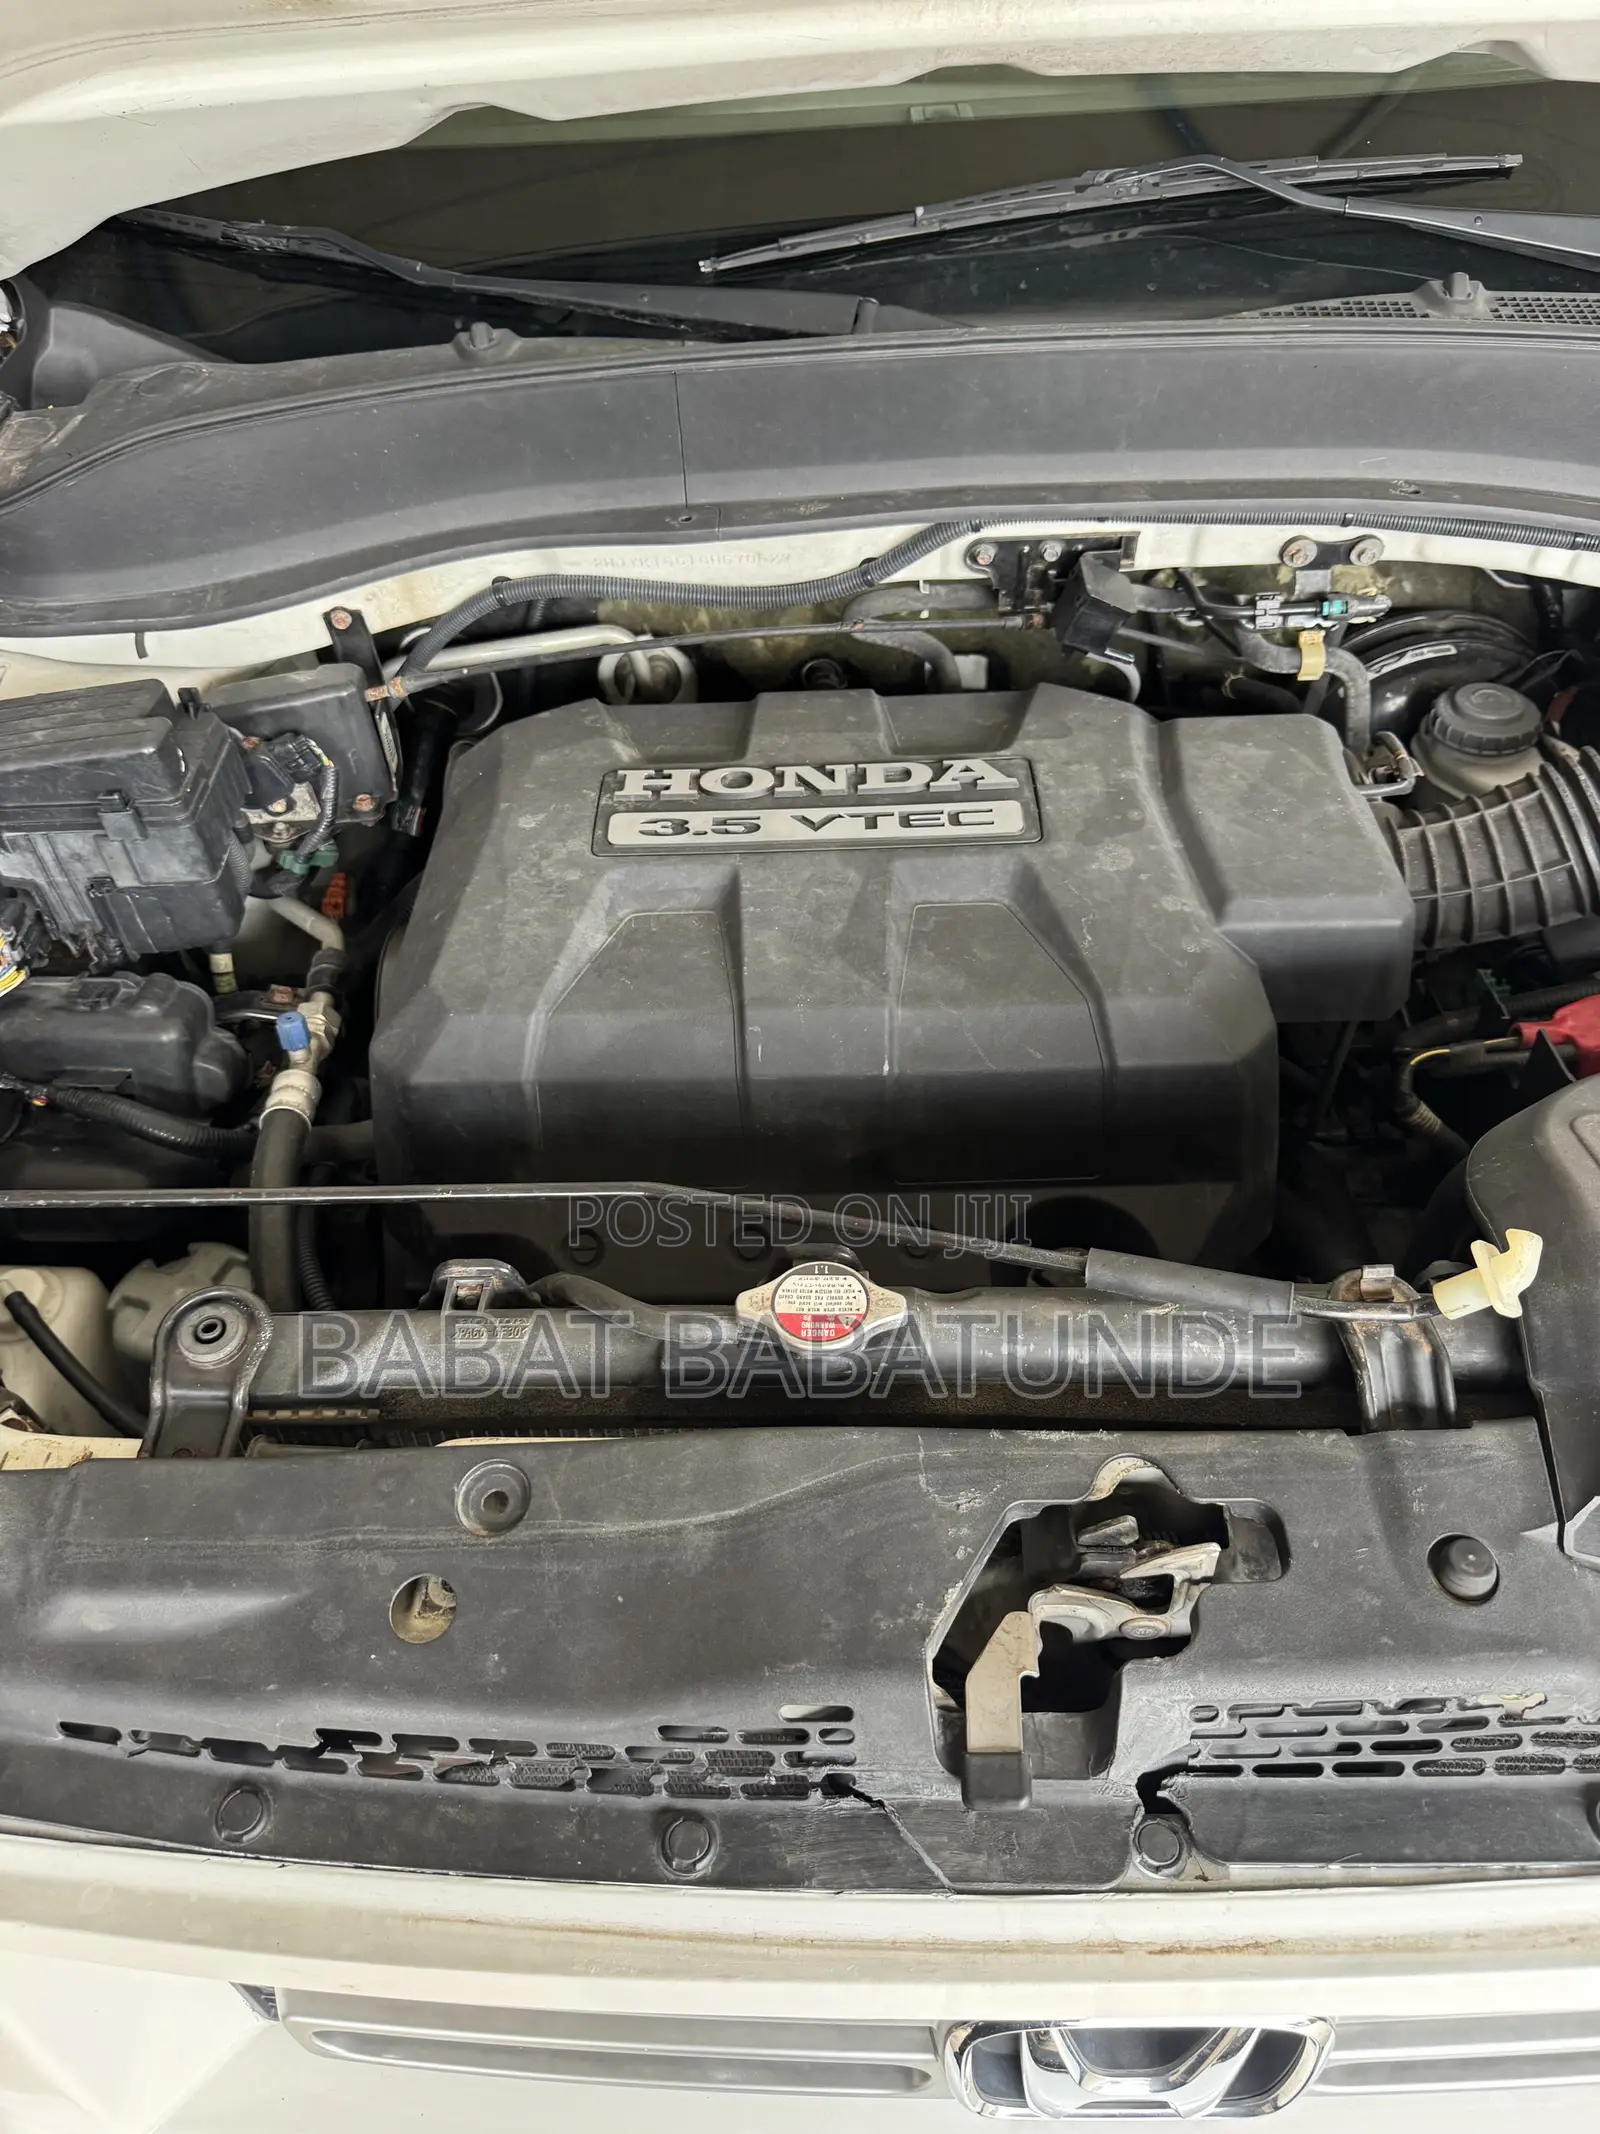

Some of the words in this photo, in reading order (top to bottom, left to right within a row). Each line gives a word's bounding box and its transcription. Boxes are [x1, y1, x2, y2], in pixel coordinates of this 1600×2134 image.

[613, 759, 1019, 801] HONDA
[638, 815, 761, 836] 3.5
[790, 808, 995, 832] VTEC
[814, 1265, 829, 1275] 1.1
[801, 1329, 836, 1337] DANGER
